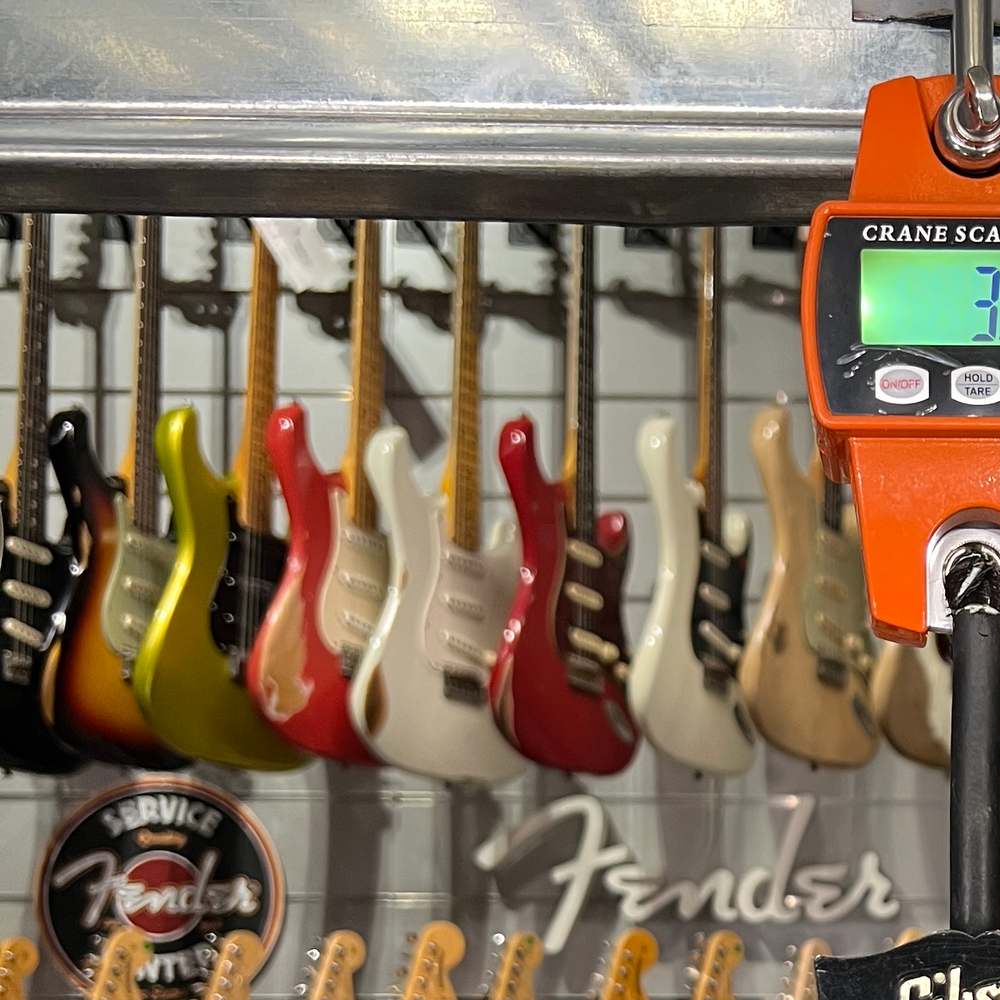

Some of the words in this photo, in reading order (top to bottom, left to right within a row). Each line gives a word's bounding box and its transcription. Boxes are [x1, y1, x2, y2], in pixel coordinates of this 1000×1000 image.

[862, 224, 948, 244] CRANE
[880, 378, 921, 391] ON/OFF
[963, 372, 993, 384] HOLD
[963, 386, 992, 397] TARE
[101, 794, 223, 839] SERVICE
[474, 792, 900, 955] Fender
[53, 849, 262, 929] Fender
